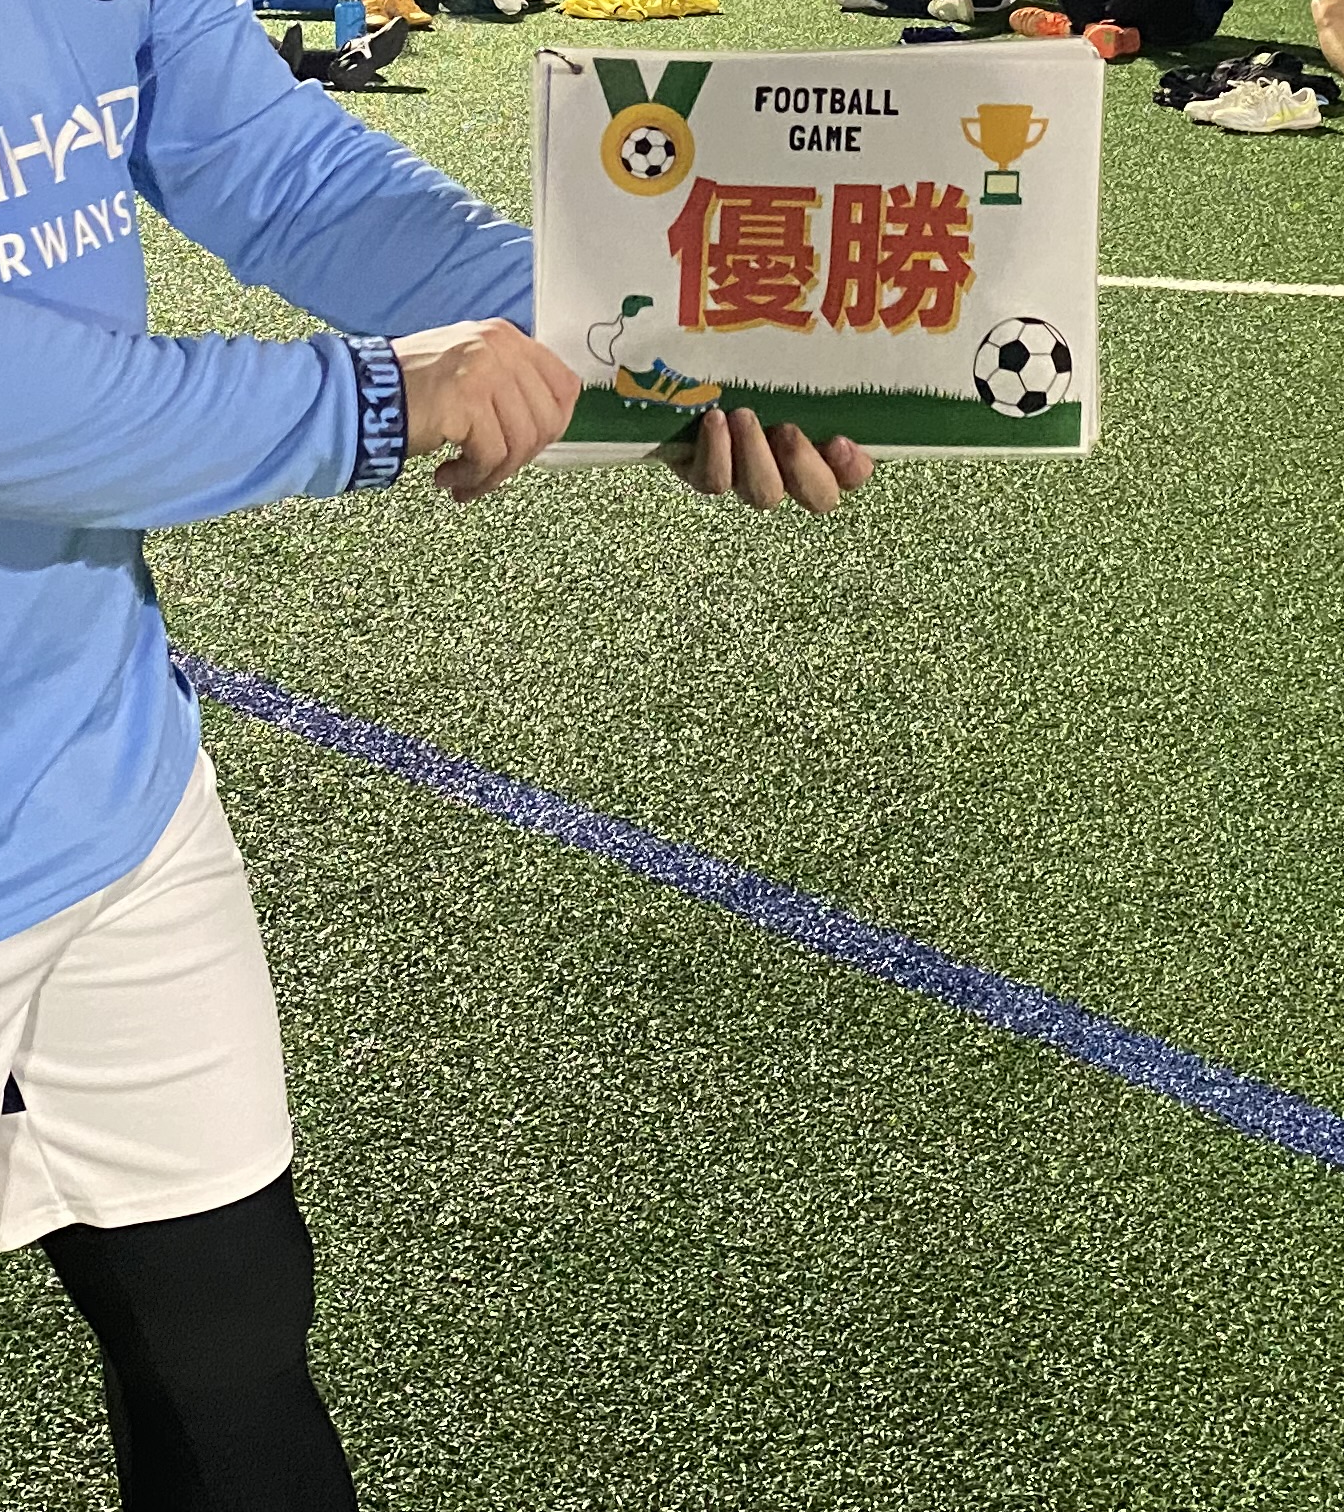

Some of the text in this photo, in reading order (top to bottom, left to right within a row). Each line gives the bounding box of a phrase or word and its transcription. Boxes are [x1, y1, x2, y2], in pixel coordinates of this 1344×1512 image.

[753, 84, 900, 117] FOOTBALL
[787, 124, 863, 153] GAME
[666, 176, 977, 335] 優勝
